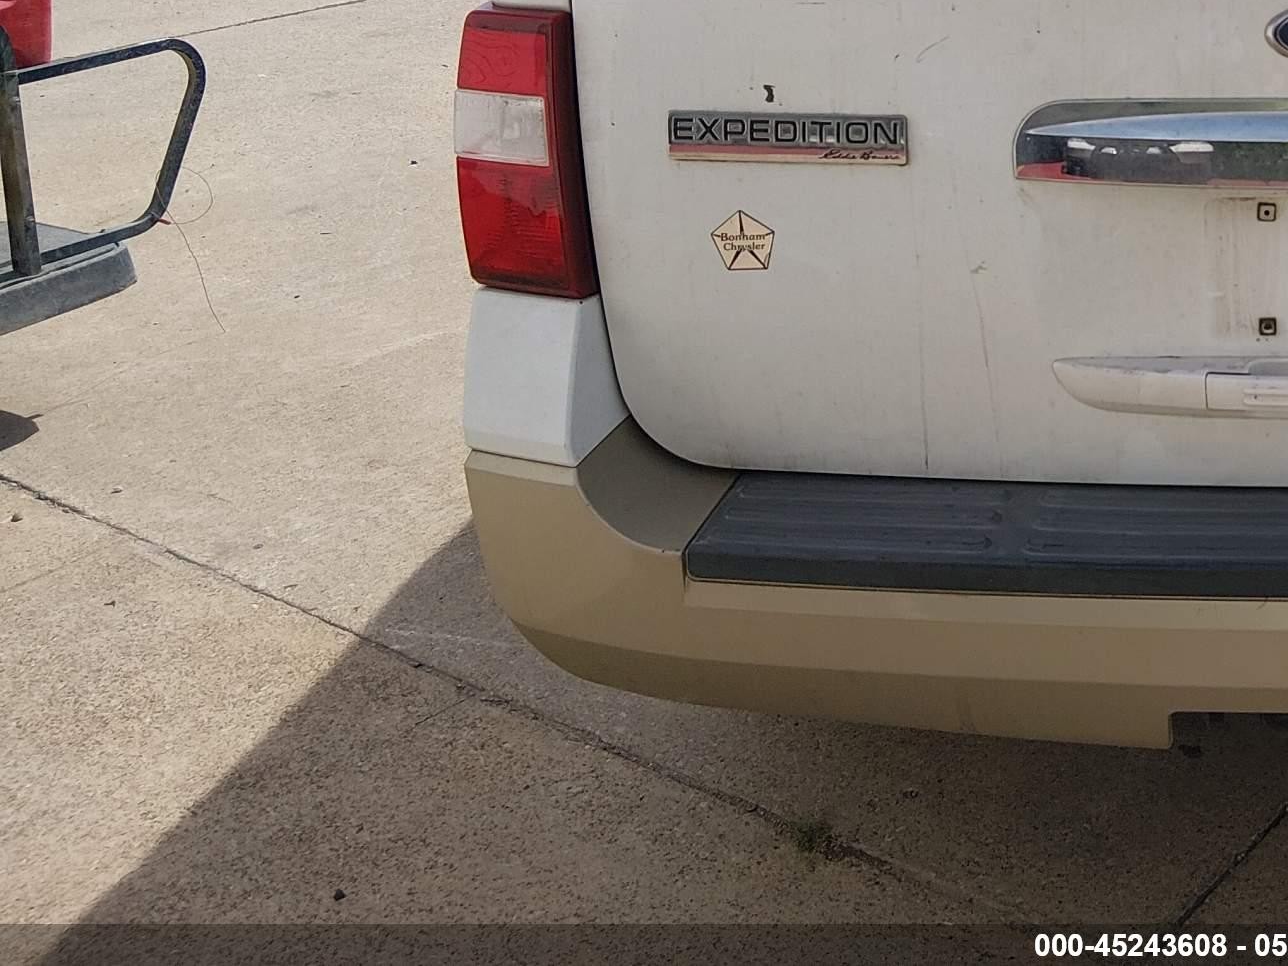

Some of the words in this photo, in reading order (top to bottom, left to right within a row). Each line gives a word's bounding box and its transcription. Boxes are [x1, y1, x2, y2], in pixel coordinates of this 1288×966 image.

[672, 118, 900, 145] EXPEDITION
[720, 232, 766, 242] Bonham
[723, 242, 767, 252] Chrysler
